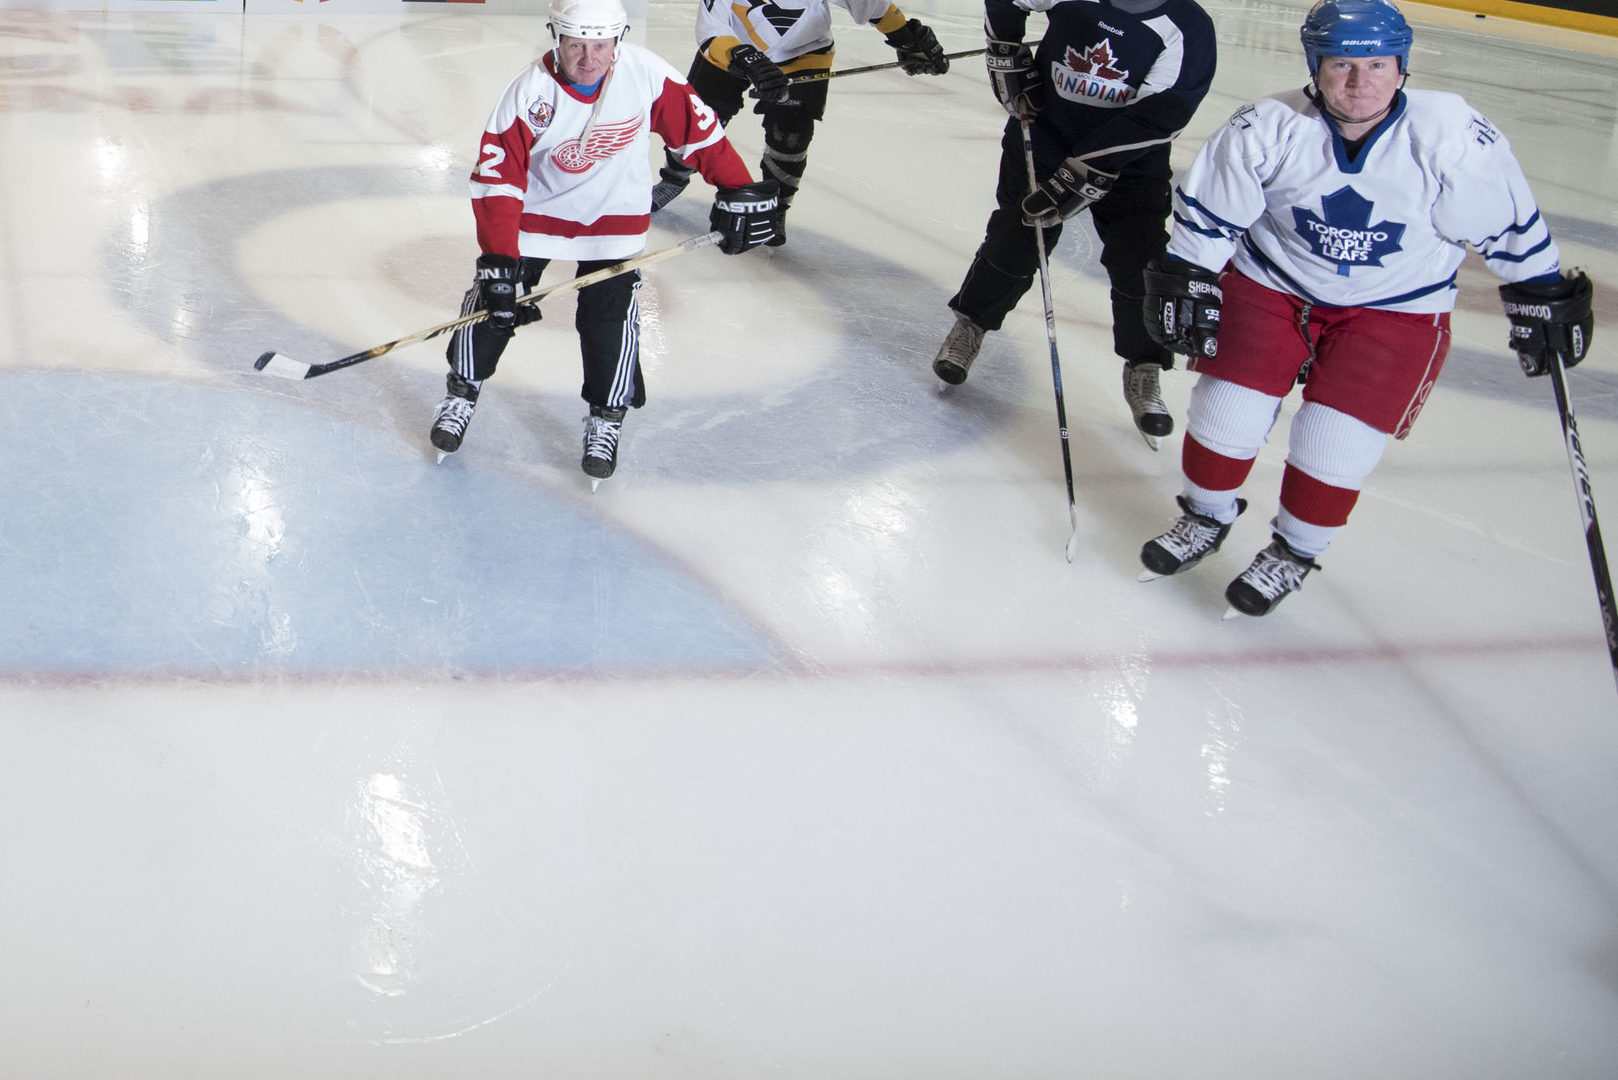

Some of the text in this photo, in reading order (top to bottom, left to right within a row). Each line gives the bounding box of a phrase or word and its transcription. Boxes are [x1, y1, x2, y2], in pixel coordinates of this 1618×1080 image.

[1098, 20, 1125, 37] Reebok
[1341, 38, 1382, 47] BAUER
[1054, 67, 1131, 103] CANADIAN
[1076, 73, 1105, 84] MOLSON
[716, 195, 779, 214] ASTON
[1307, 220, 1389, 242] TORONTO
[1319, 235, 1373, 252] MAPLE
[1322, 245, 1369, 261] LEAFS
[1165, 305, 1173, 332] PRO
[1574, 327, 1582, 355] PRO
